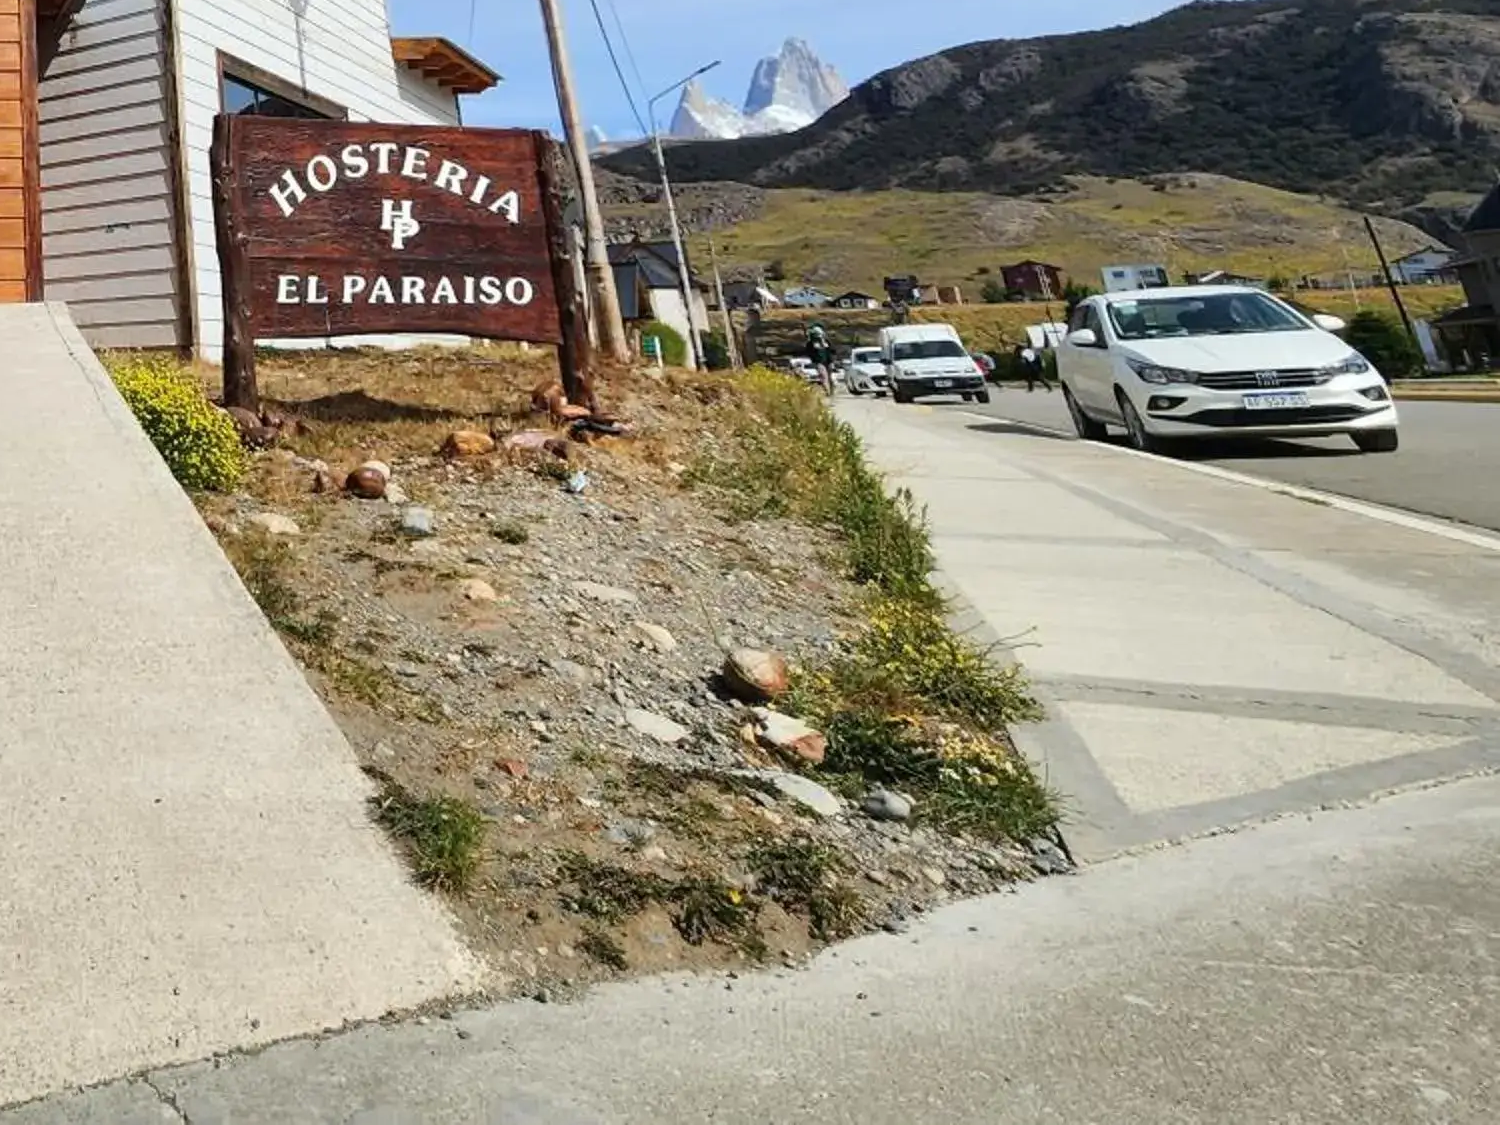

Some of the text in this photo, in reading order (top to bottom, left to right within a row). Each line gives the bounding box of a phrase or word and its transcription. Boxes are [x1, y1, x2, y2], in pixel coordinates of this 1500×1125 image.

[268, 142, 520, 224] HOSTERIA
[276, 275, 533, 305] EL PARAISO
